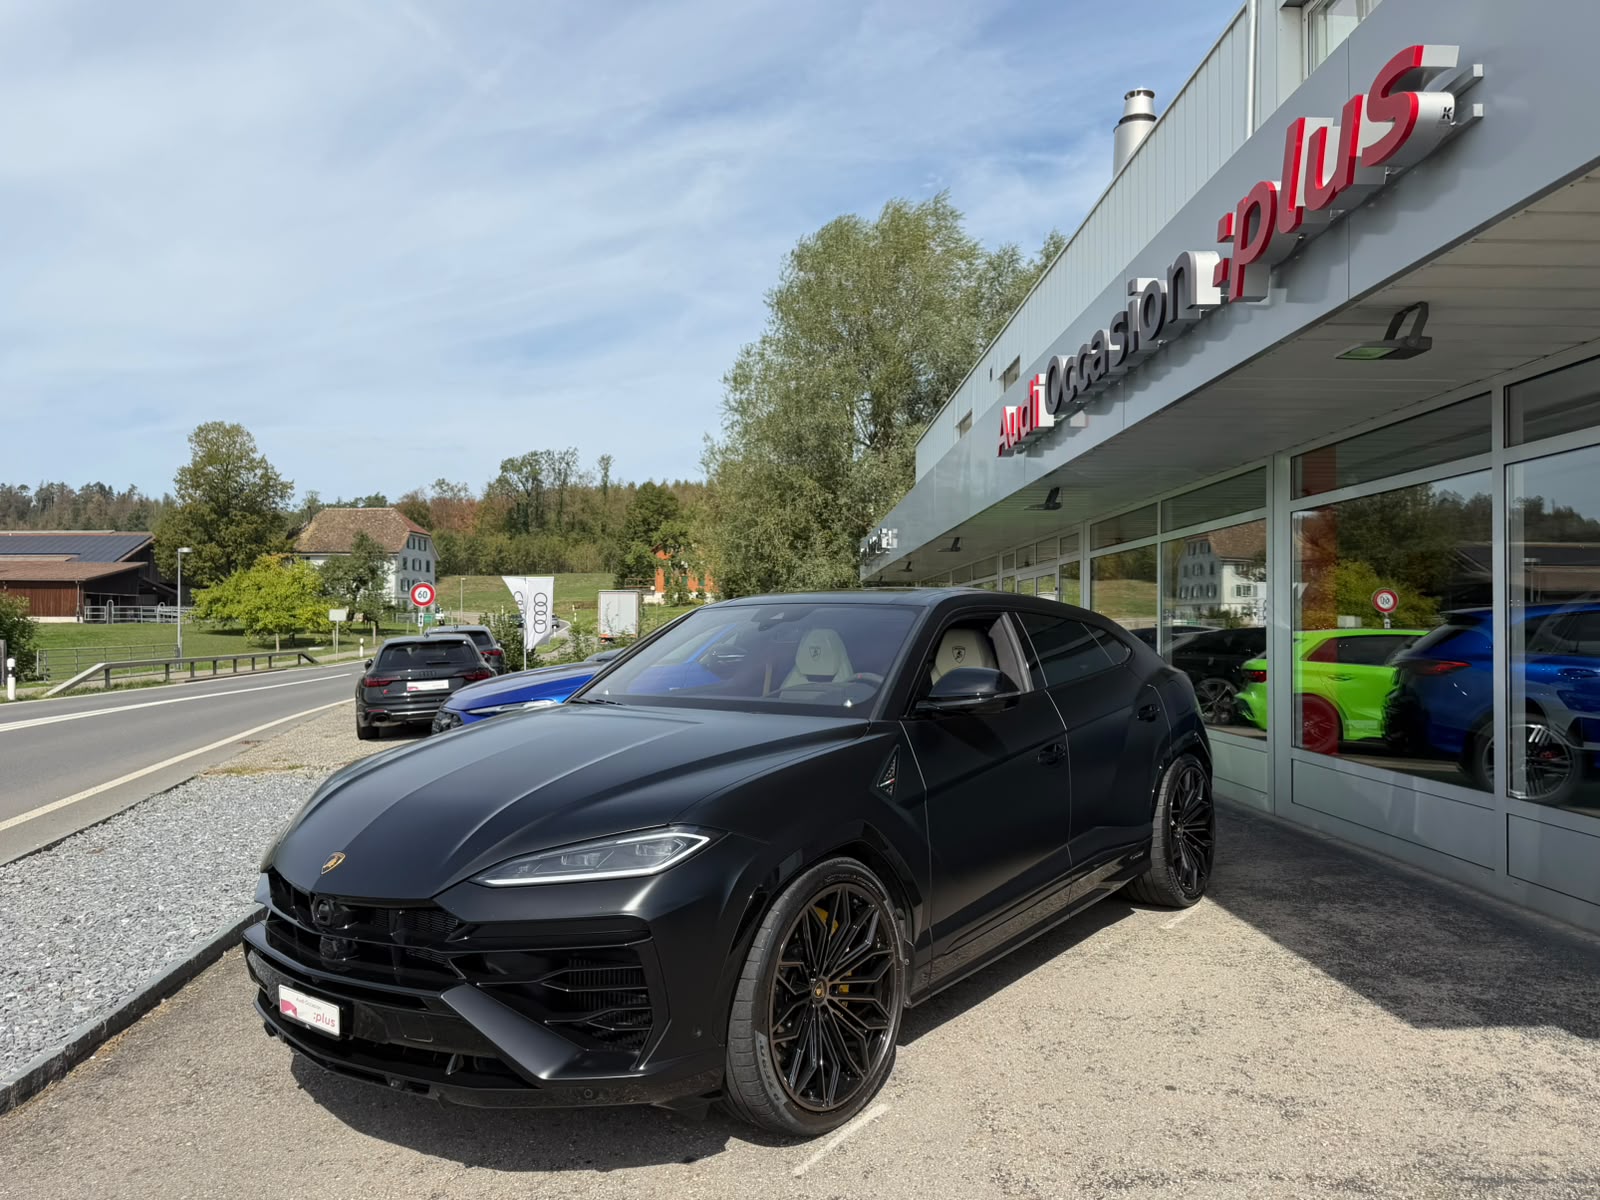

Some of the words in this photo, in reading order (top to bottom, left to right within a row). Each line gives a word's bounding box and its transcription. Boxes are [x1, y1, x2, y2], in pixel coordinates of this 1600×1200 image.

[998, 373, 1051, 457] Audi
[1045, 251, 1217, 415] Occasion
[417, 590, 428, 599] 60
